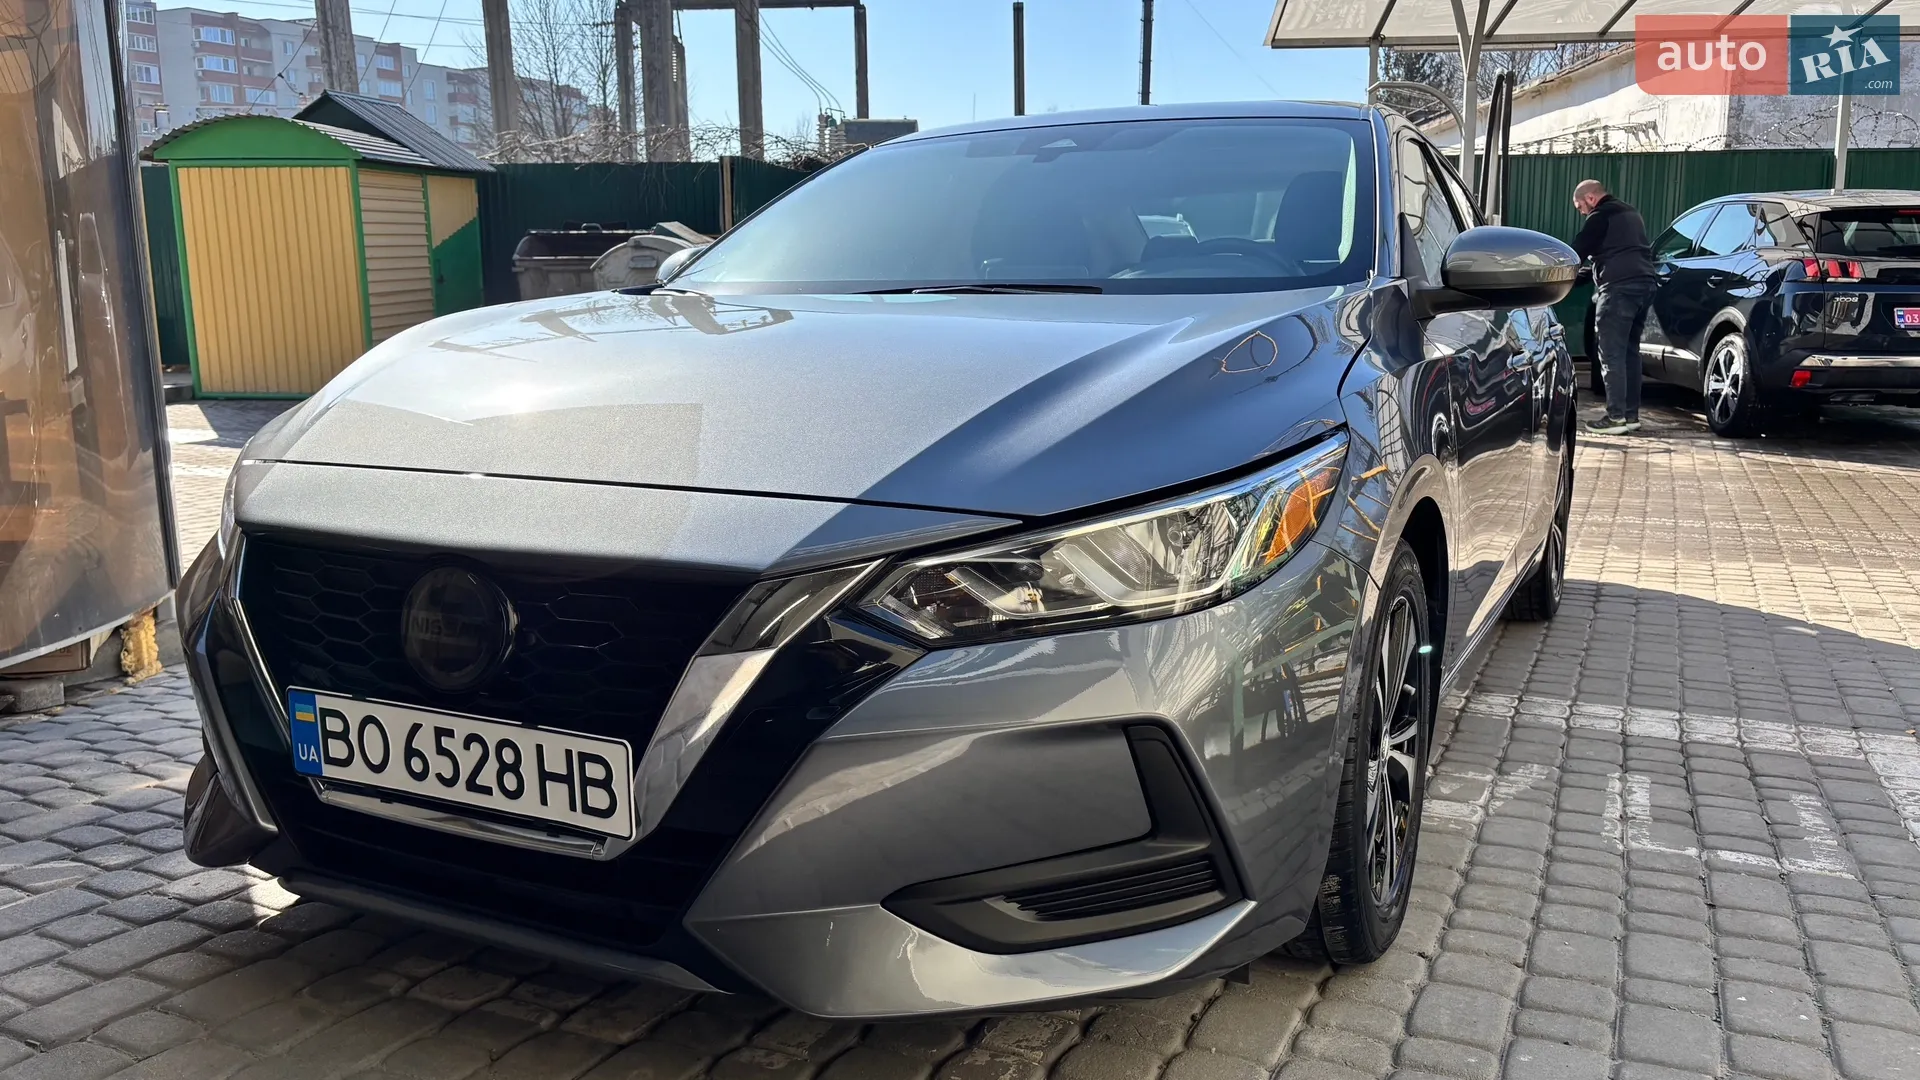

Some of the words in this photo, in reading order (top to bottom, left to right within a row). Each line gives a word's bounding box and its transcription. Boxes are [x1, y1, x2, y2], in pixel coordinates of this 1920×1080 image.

[1905, 314, 1919, 323] 03
[298, 743, 319, 763] UA
[318, 707, 390, 774] BO
[404, 722, 525, 800] 6528
[536, 743, 618, 819] HB
